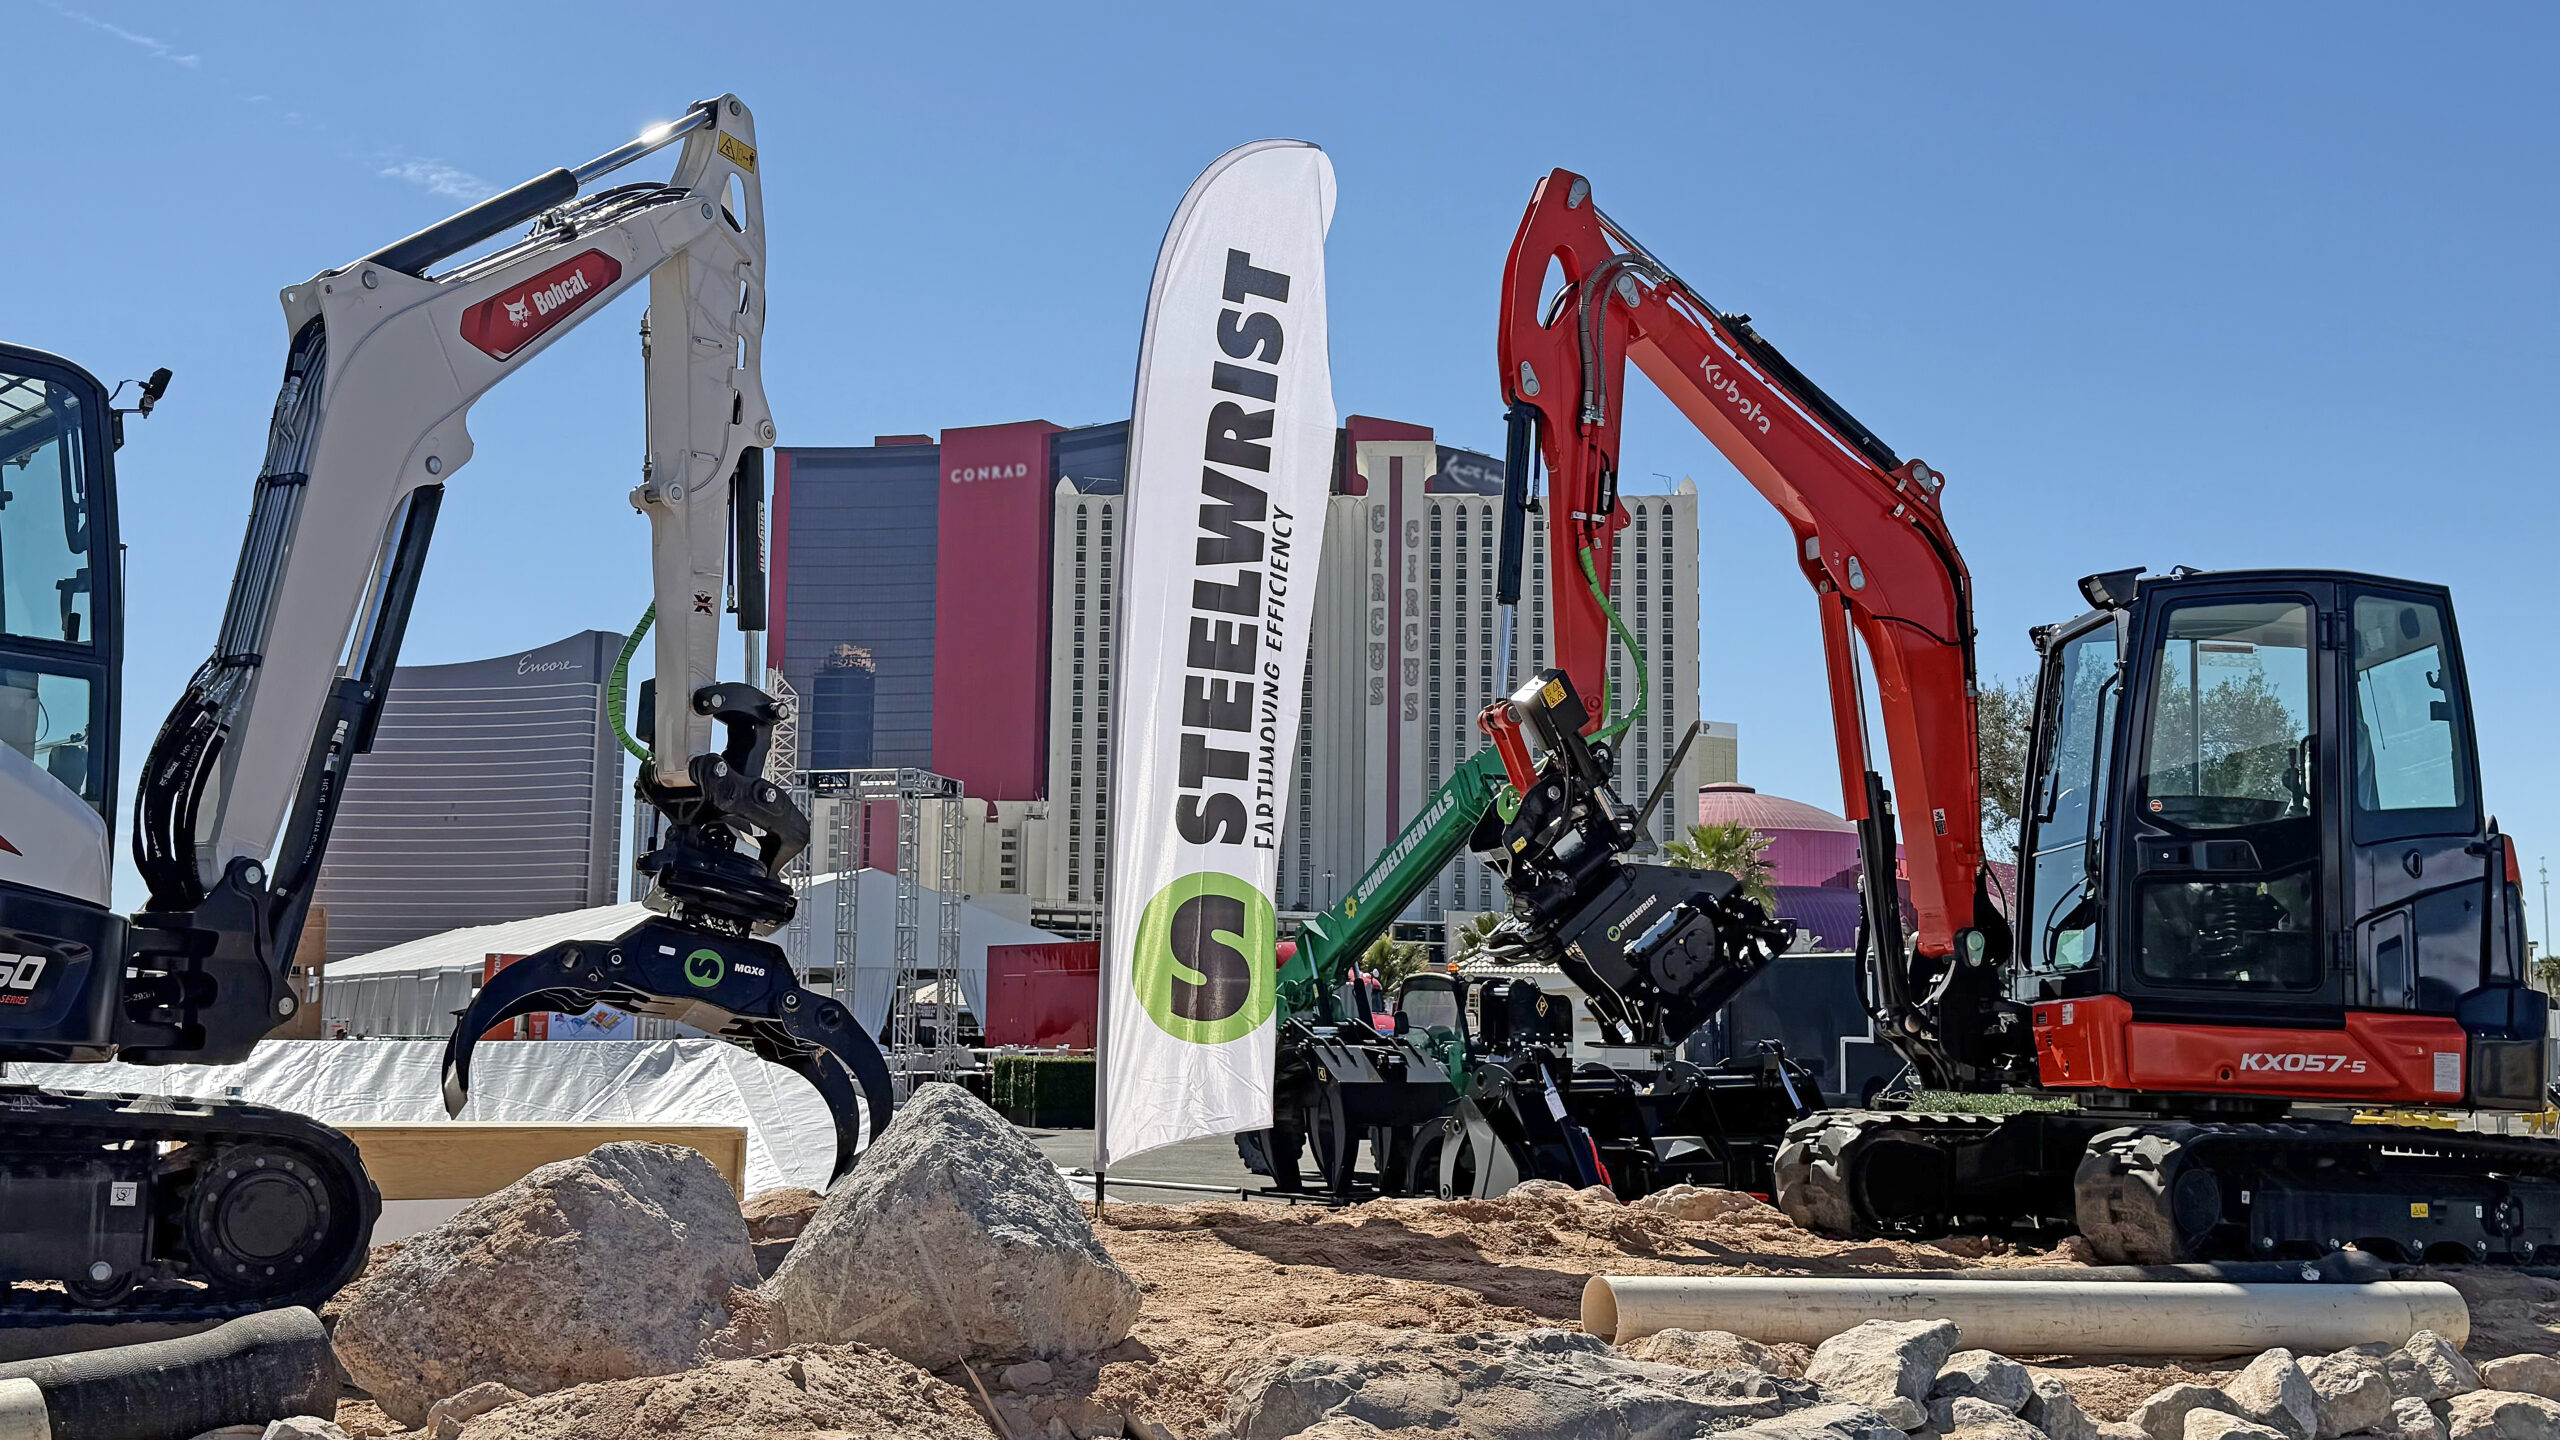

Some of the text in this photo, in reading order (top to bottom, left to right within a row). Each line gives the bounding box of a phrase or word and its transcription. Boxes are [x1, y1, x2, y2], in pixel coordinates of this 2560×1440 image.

[532, 269, 589, 316] Bobcat
[1700, 354, 1771, 434] Kubota
[951, 463, 1027, 483] CONRAD
[1175, 248, 1290, 845] STEELWRIST
[1266, 504, 1294, 653] EFFICIENCY
[1370, 504, 1385, 706] CIRCUS
[1403, 519, 1420, 722] CIRCUS
[517, 653, 582, 675] Encore
[1619, 894, 1657, 930] STEELWRIST
[734, 963, 766, 977] MGX6
[2240, 1053, 2367, 1073] KX057-5
